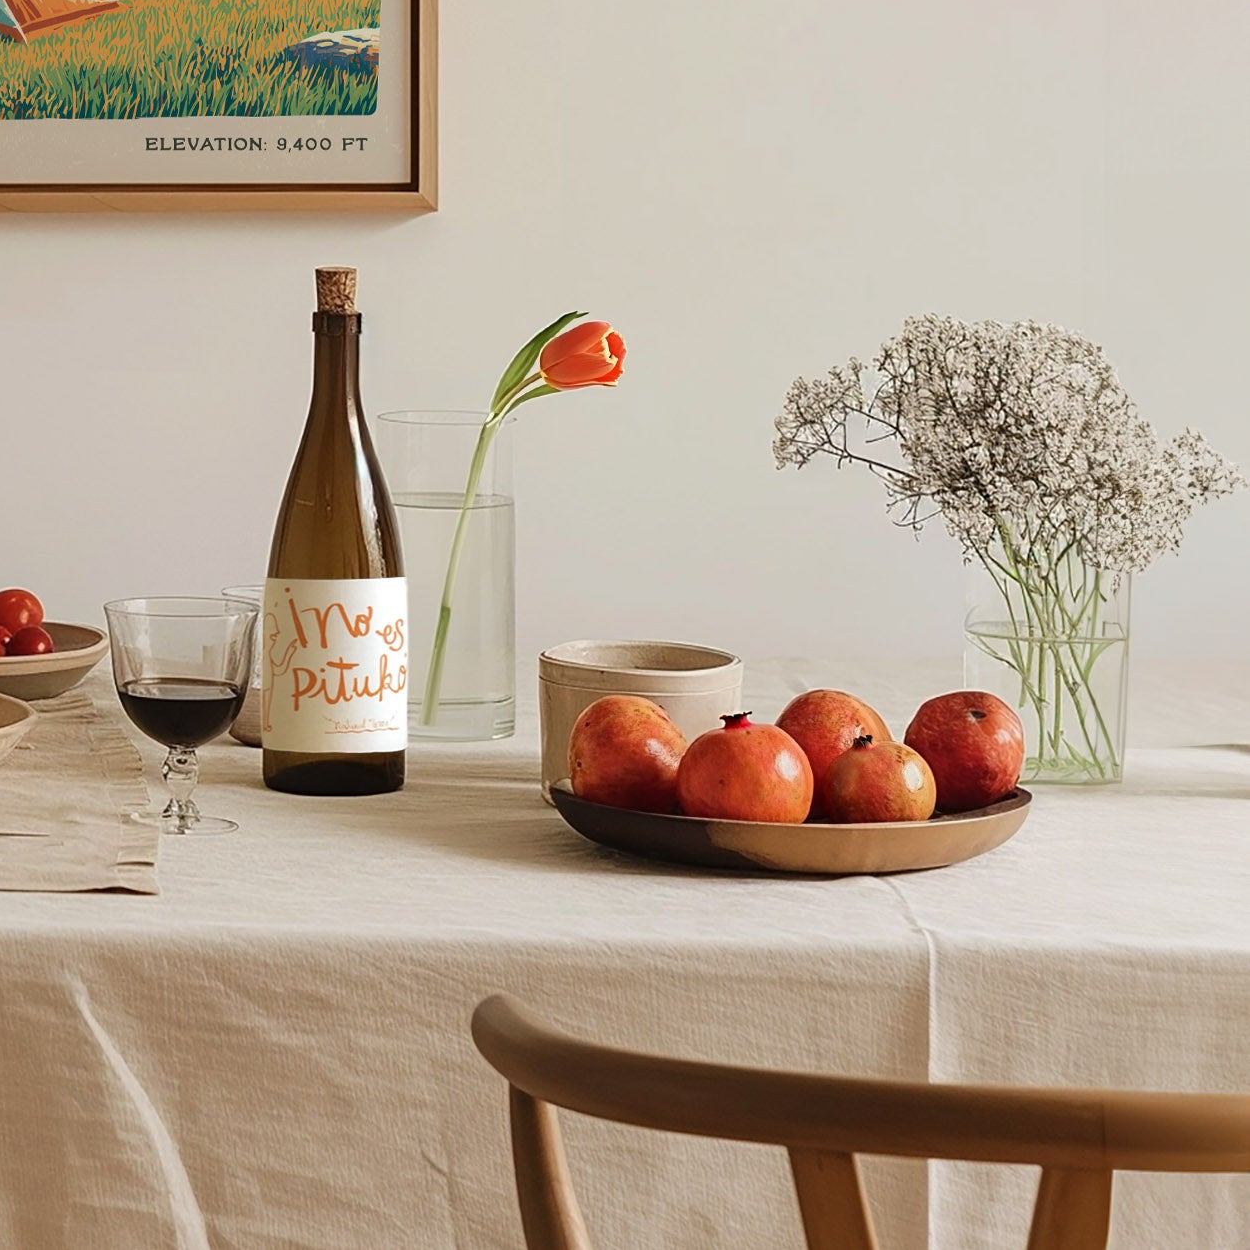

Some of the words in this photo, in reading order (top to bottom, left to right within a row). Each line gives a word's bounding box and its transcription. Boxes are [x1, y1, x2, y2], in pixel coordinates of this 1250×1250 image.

[145, 137, 267, 151] ELEVATION:
[276, 137, 332, 153] 9,400
[342, 137, 368, 151] FT
[375, 618, 405, 652] es
